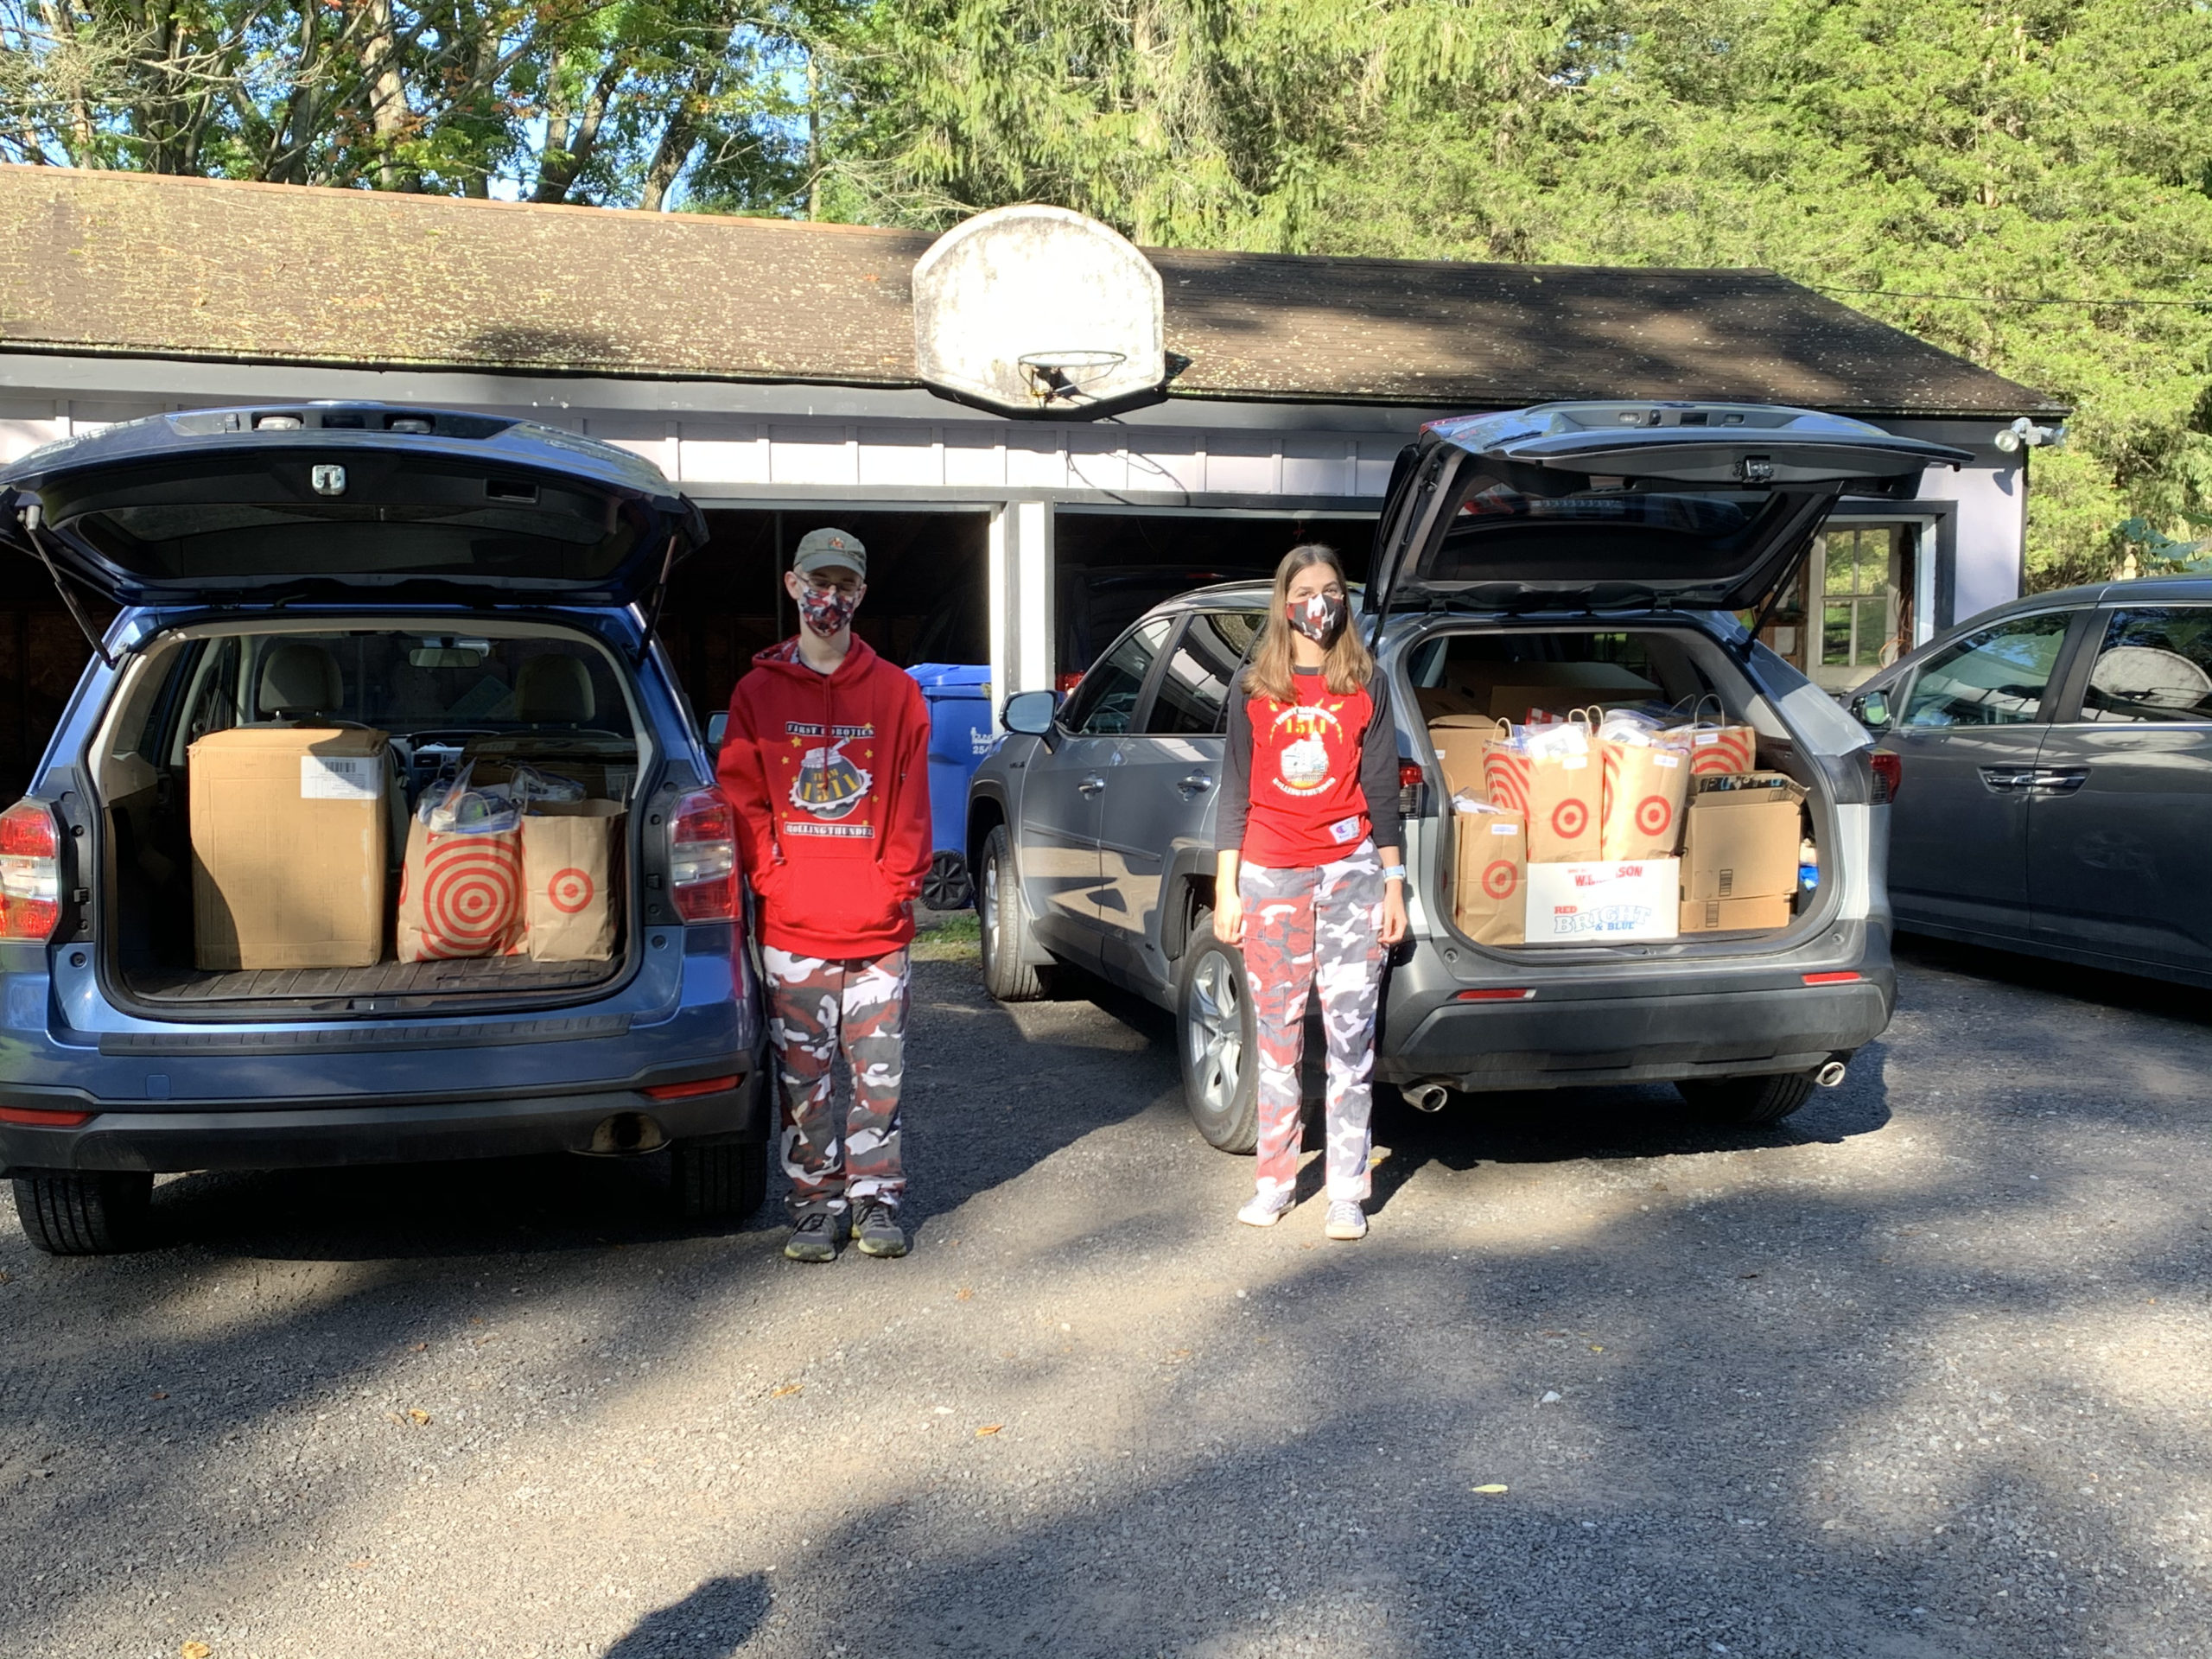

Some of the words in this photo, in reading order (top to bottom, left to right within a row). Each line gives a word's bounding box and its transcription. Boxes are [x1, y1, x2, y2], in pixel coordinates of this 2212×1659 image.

[787, 724, 817, 734] FIRST
[1286, 718, 1325, 734] 1511
[804, 773, 859, 802] 1511
[786, 824, 827, 835] ROLLING
[1554, 906, 1578, 915] RED
[1554, 904, 1652, 933] BRIGHT
[1595, 922, 1603, 931] &
[1607, 921, 1635, 931] BLUE
